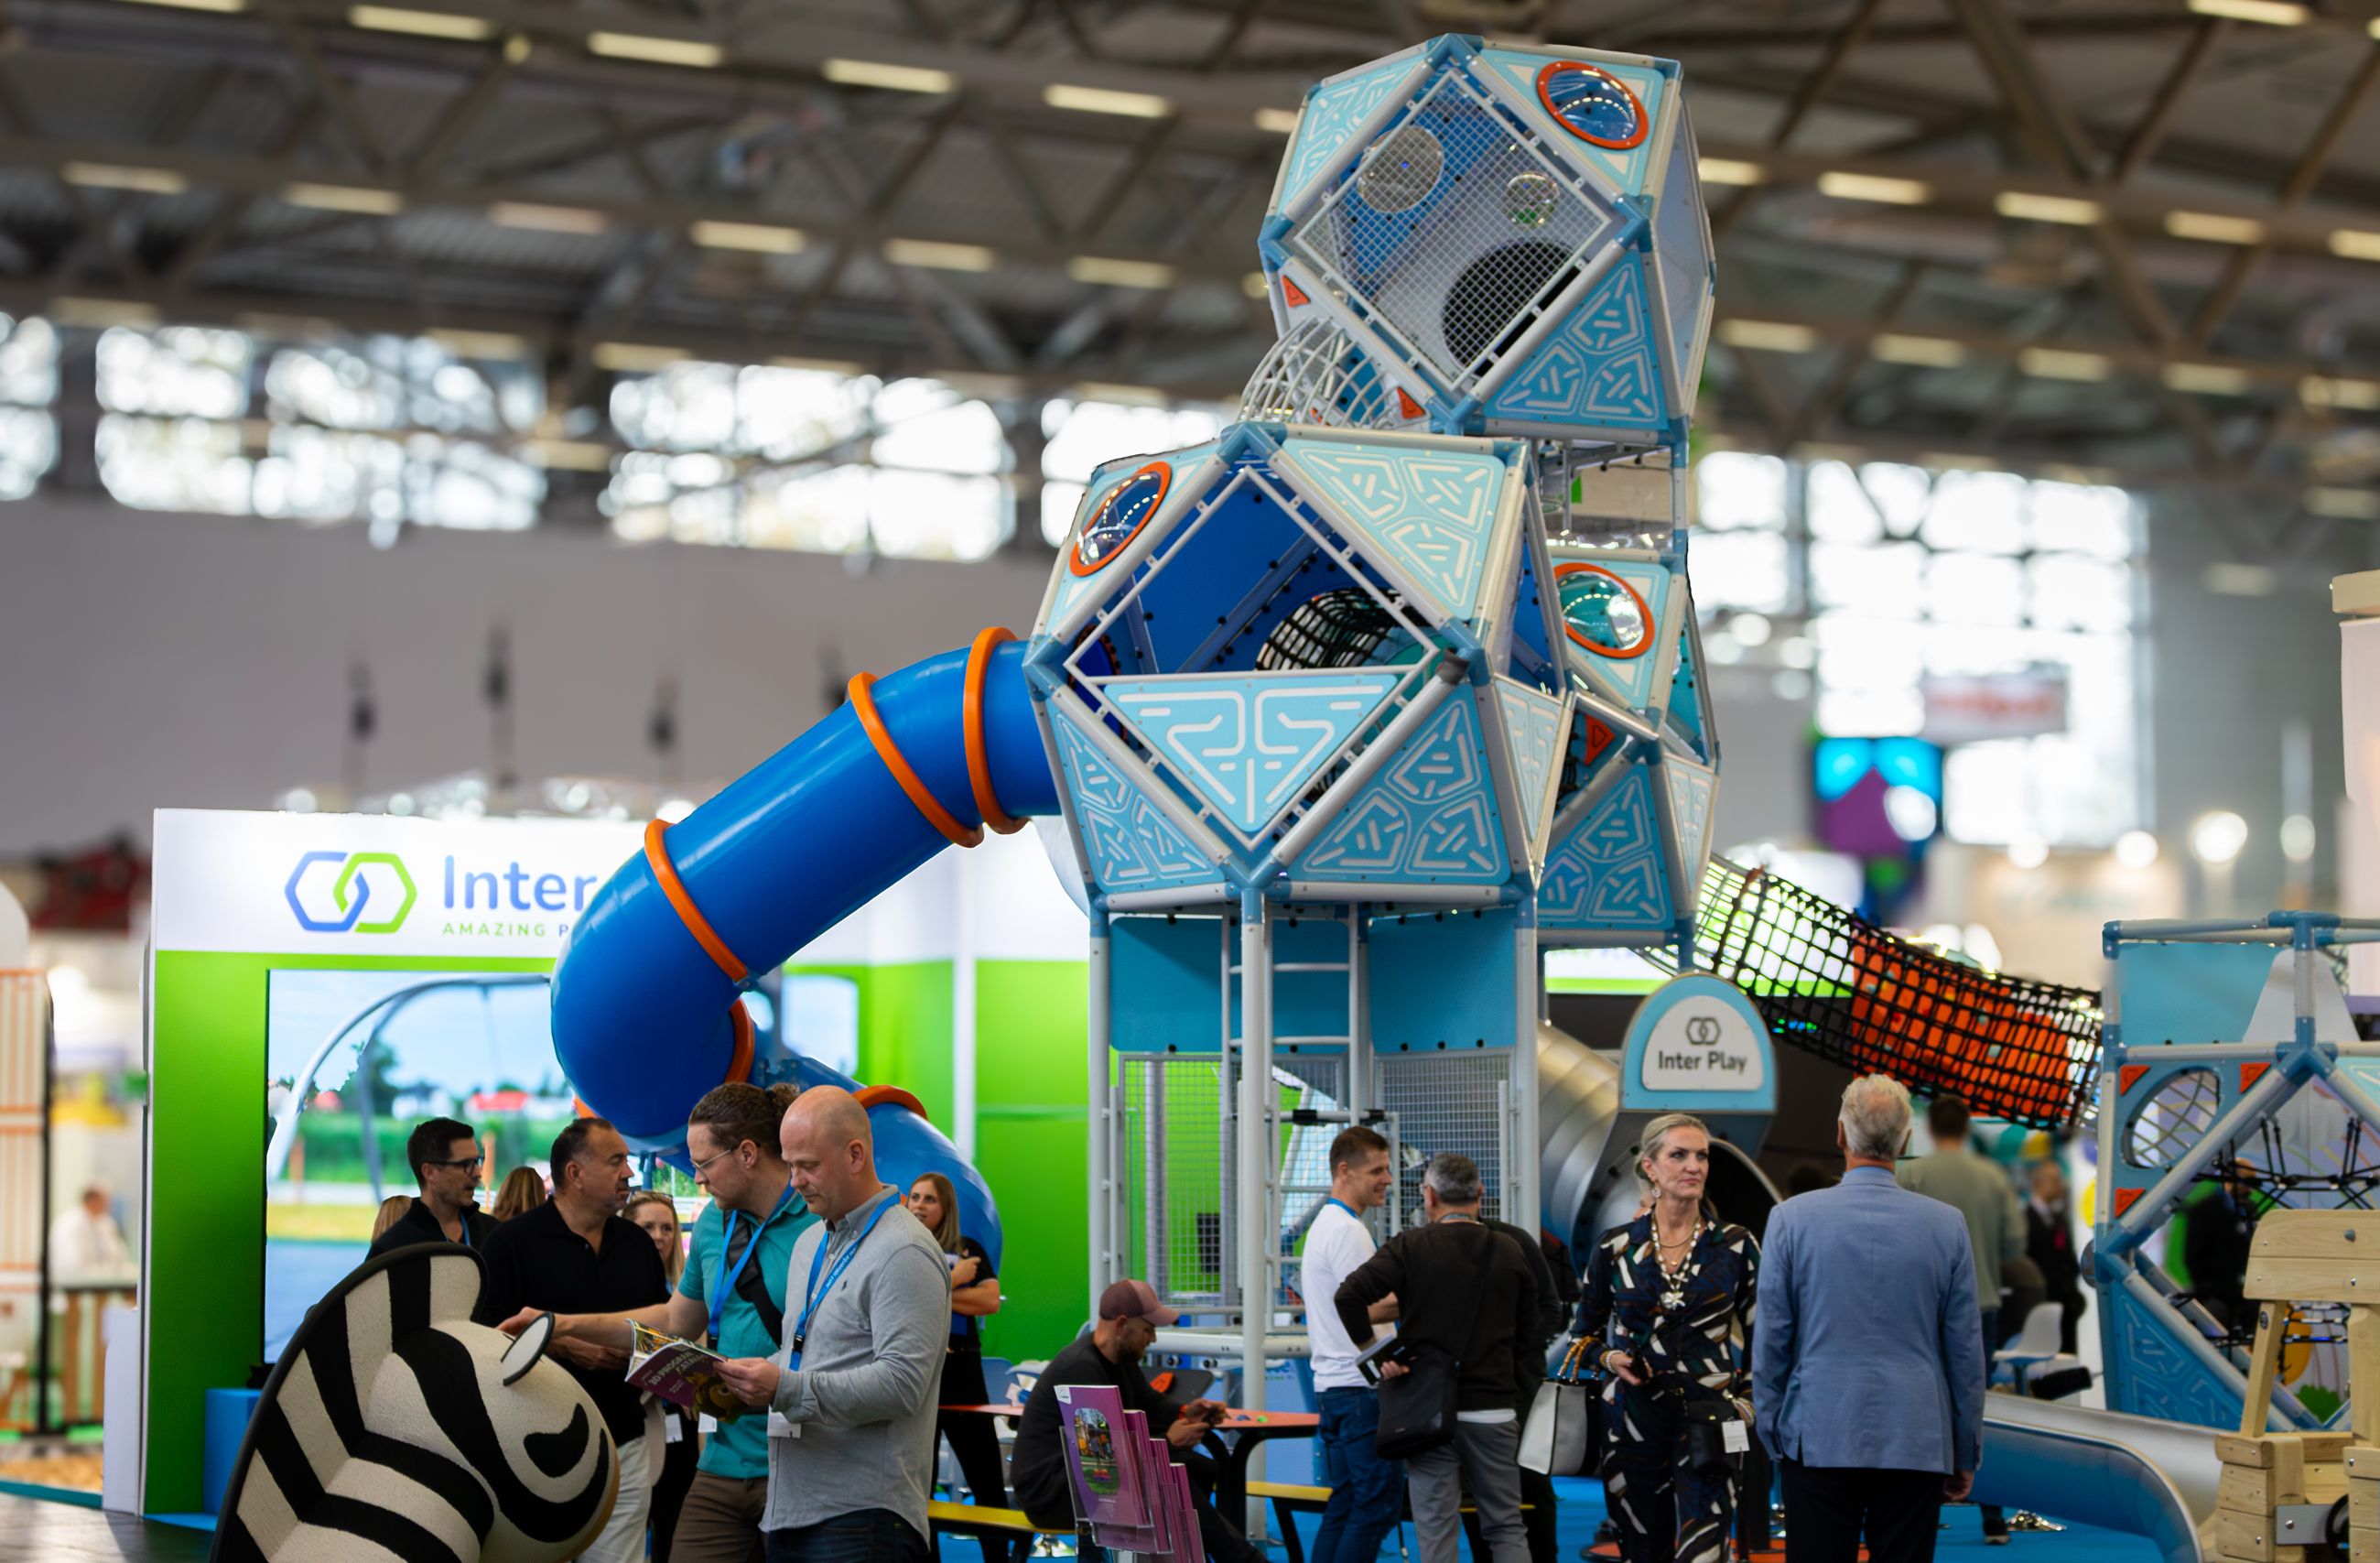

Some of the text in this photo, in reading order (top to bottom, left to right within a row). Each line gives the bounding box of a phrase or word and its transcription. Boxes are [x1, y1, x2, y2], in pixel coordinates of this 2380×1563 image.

[444, 854, 597, 911] Inter
[442, 922, 546, 937] AMAZING
[1659, 1050, 1747, 1075] Inter Play
